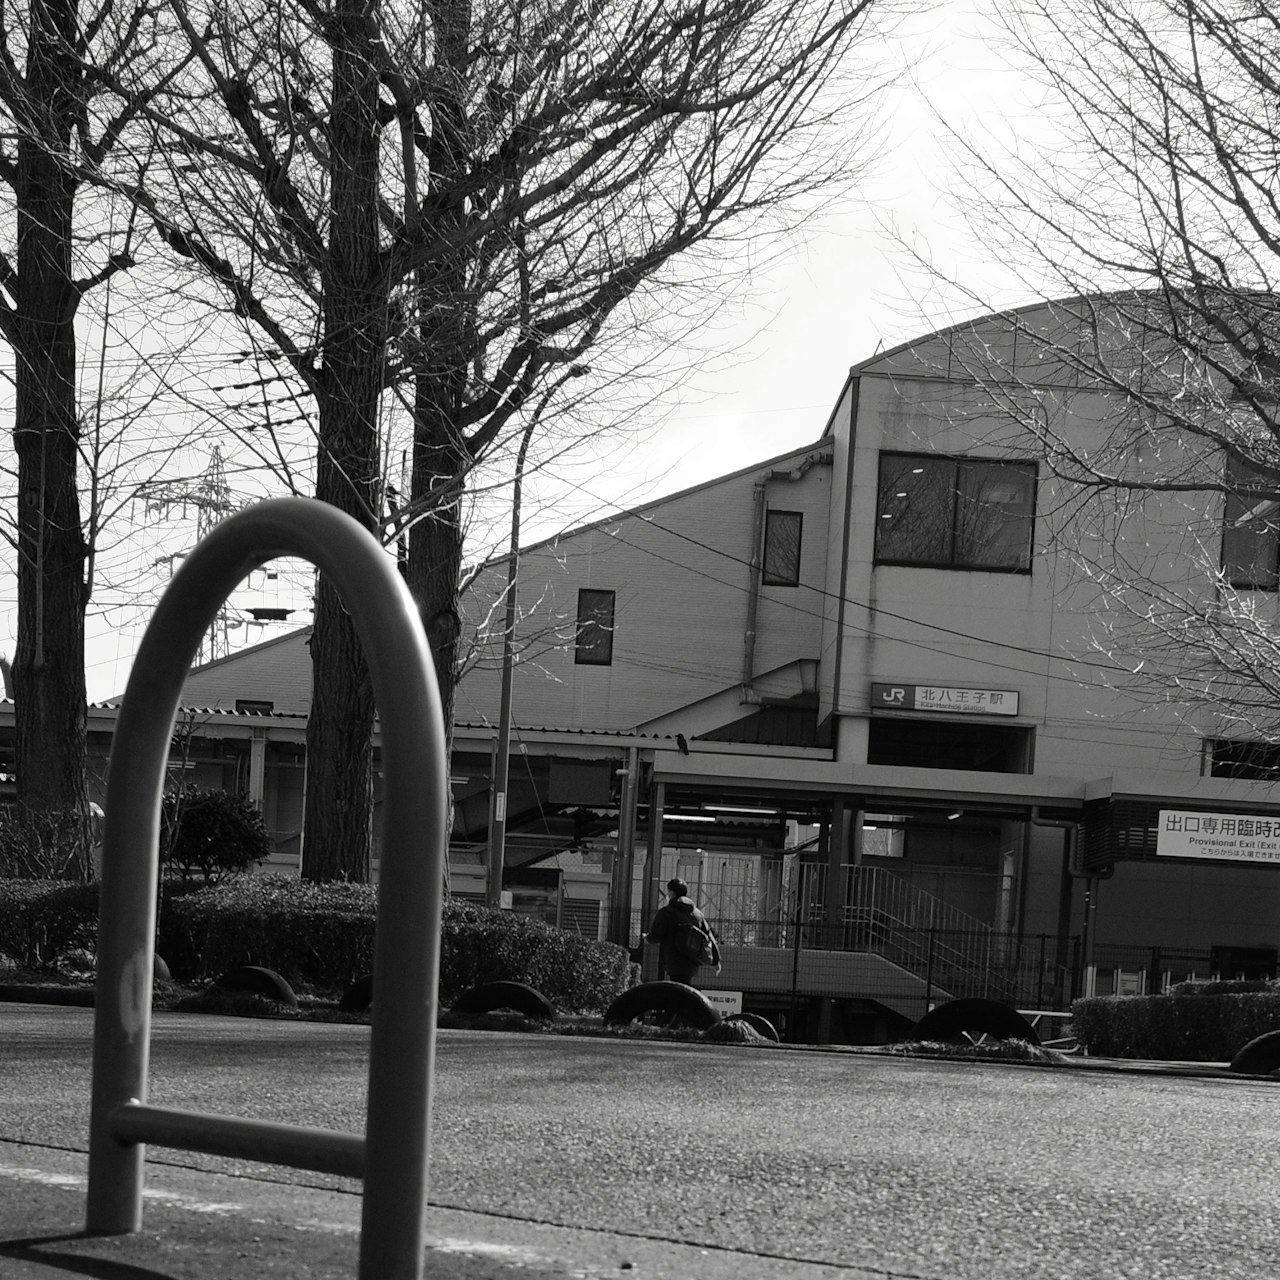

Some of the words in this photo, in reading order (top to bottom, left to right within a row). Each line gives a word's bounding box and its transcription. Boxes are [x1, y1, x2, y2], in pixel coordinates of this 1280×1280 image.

[882, 688, 905, 702] JR
[921, 689, 1004, 705] 北八王子駅
[1189, 836, 1237, 848] Provisional
[1239, 839, 1256, 849] Exit
[1257, 840, 1277, 851] (Exit
